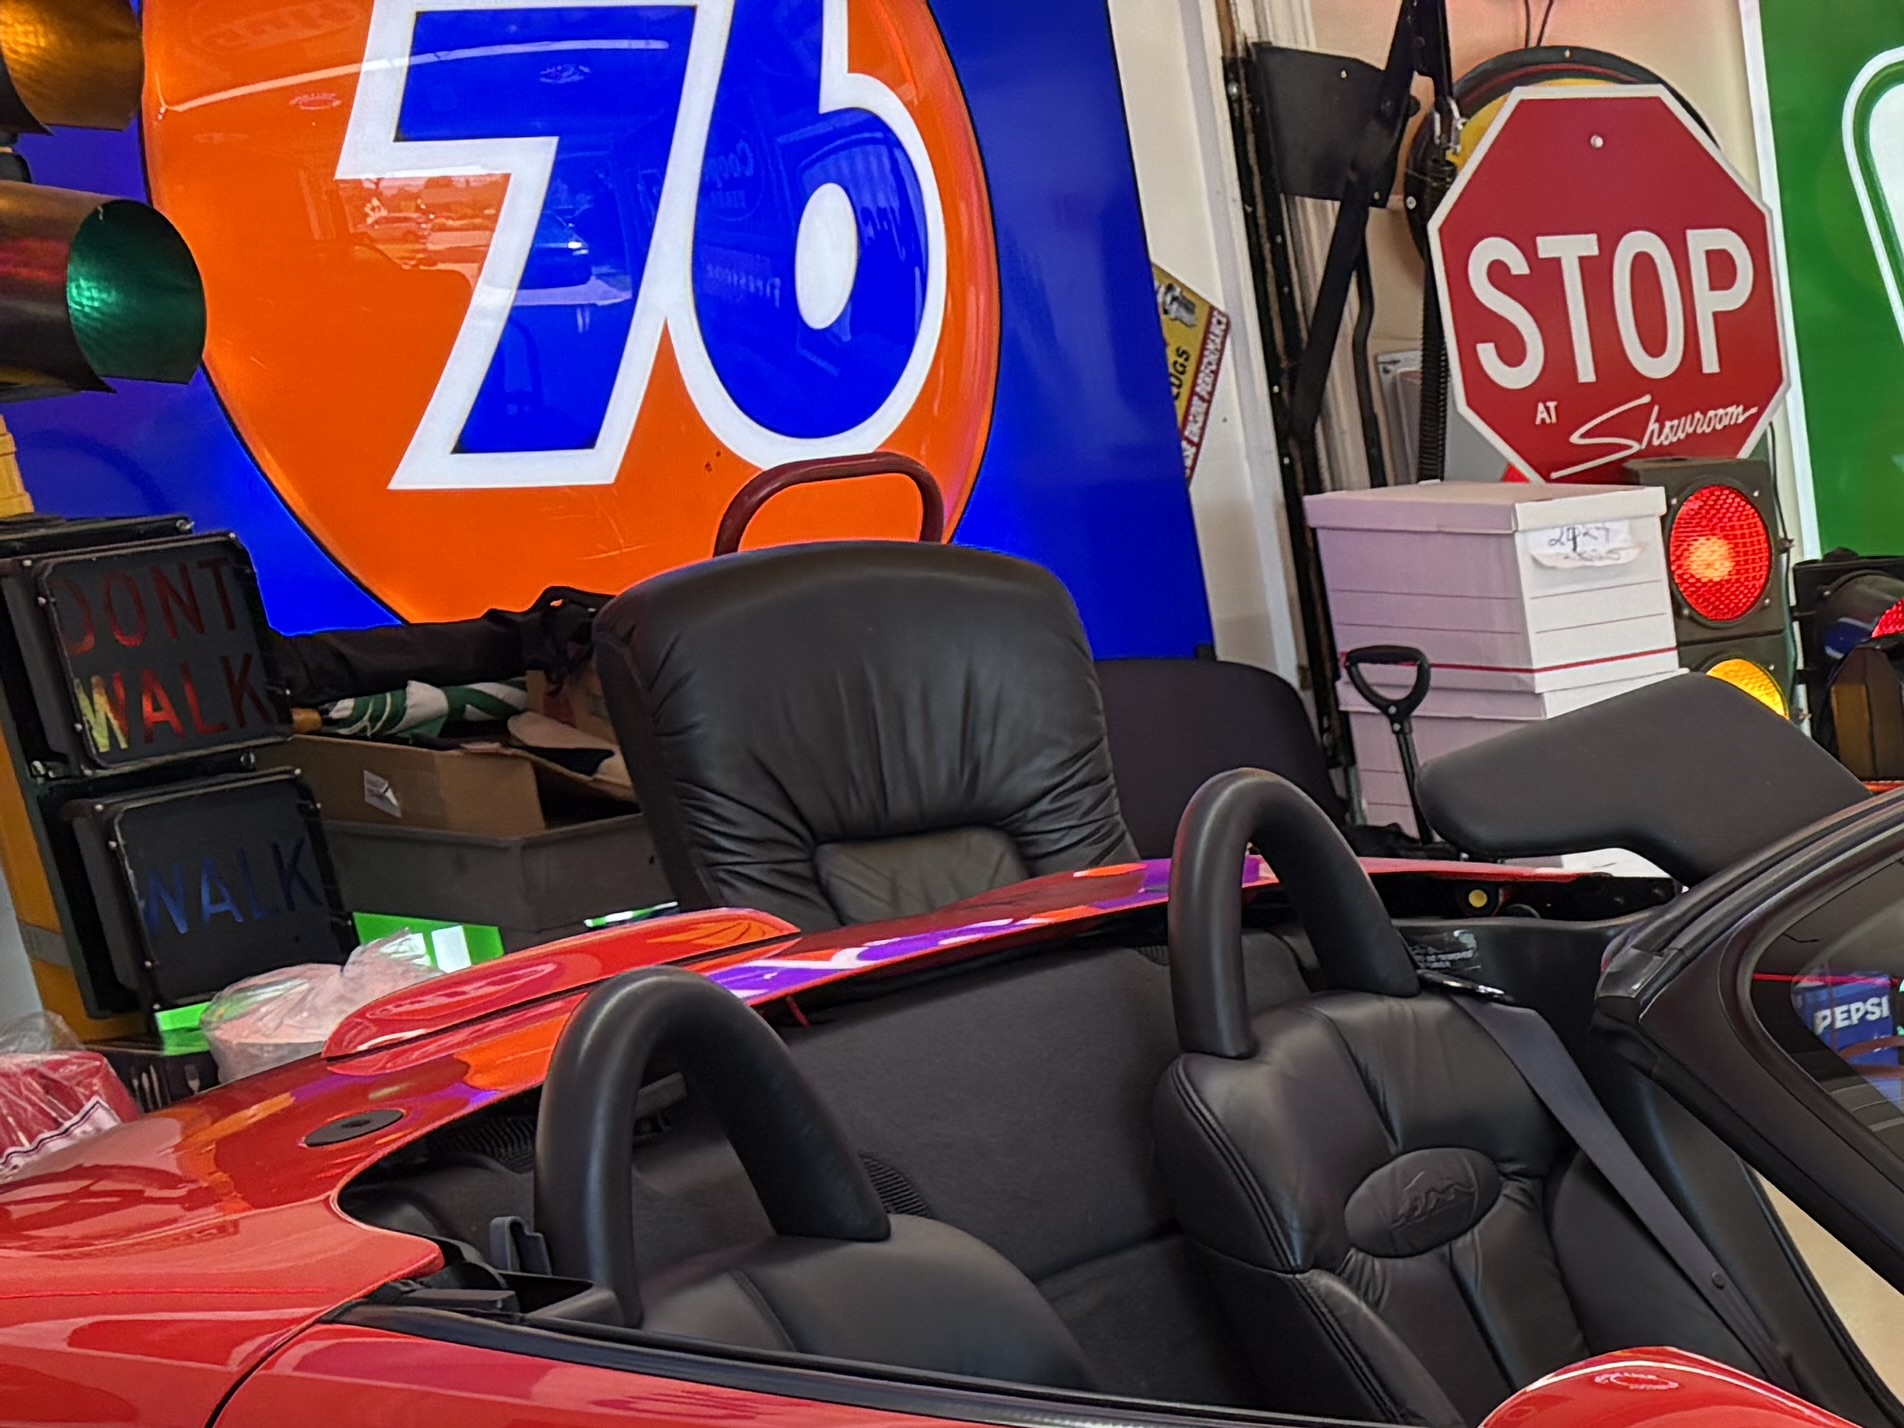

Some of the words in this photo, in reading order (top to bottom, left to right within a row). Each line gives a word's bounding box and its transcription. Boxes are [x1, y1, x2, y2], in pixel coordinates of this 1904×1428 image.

[336, 0, 942, 489] 76
[1468, 228, 1753, 389] STOP
[1536, 401, 1557, 425] AT
[1551, 394, 1757, 479] Showroom
[57, 557, 236, 657] DONT
[73, 653, 271, 752] WALK
[144, 837, 325, 934] WALK
[1814, 995, 1890, 1036] PEPSI
